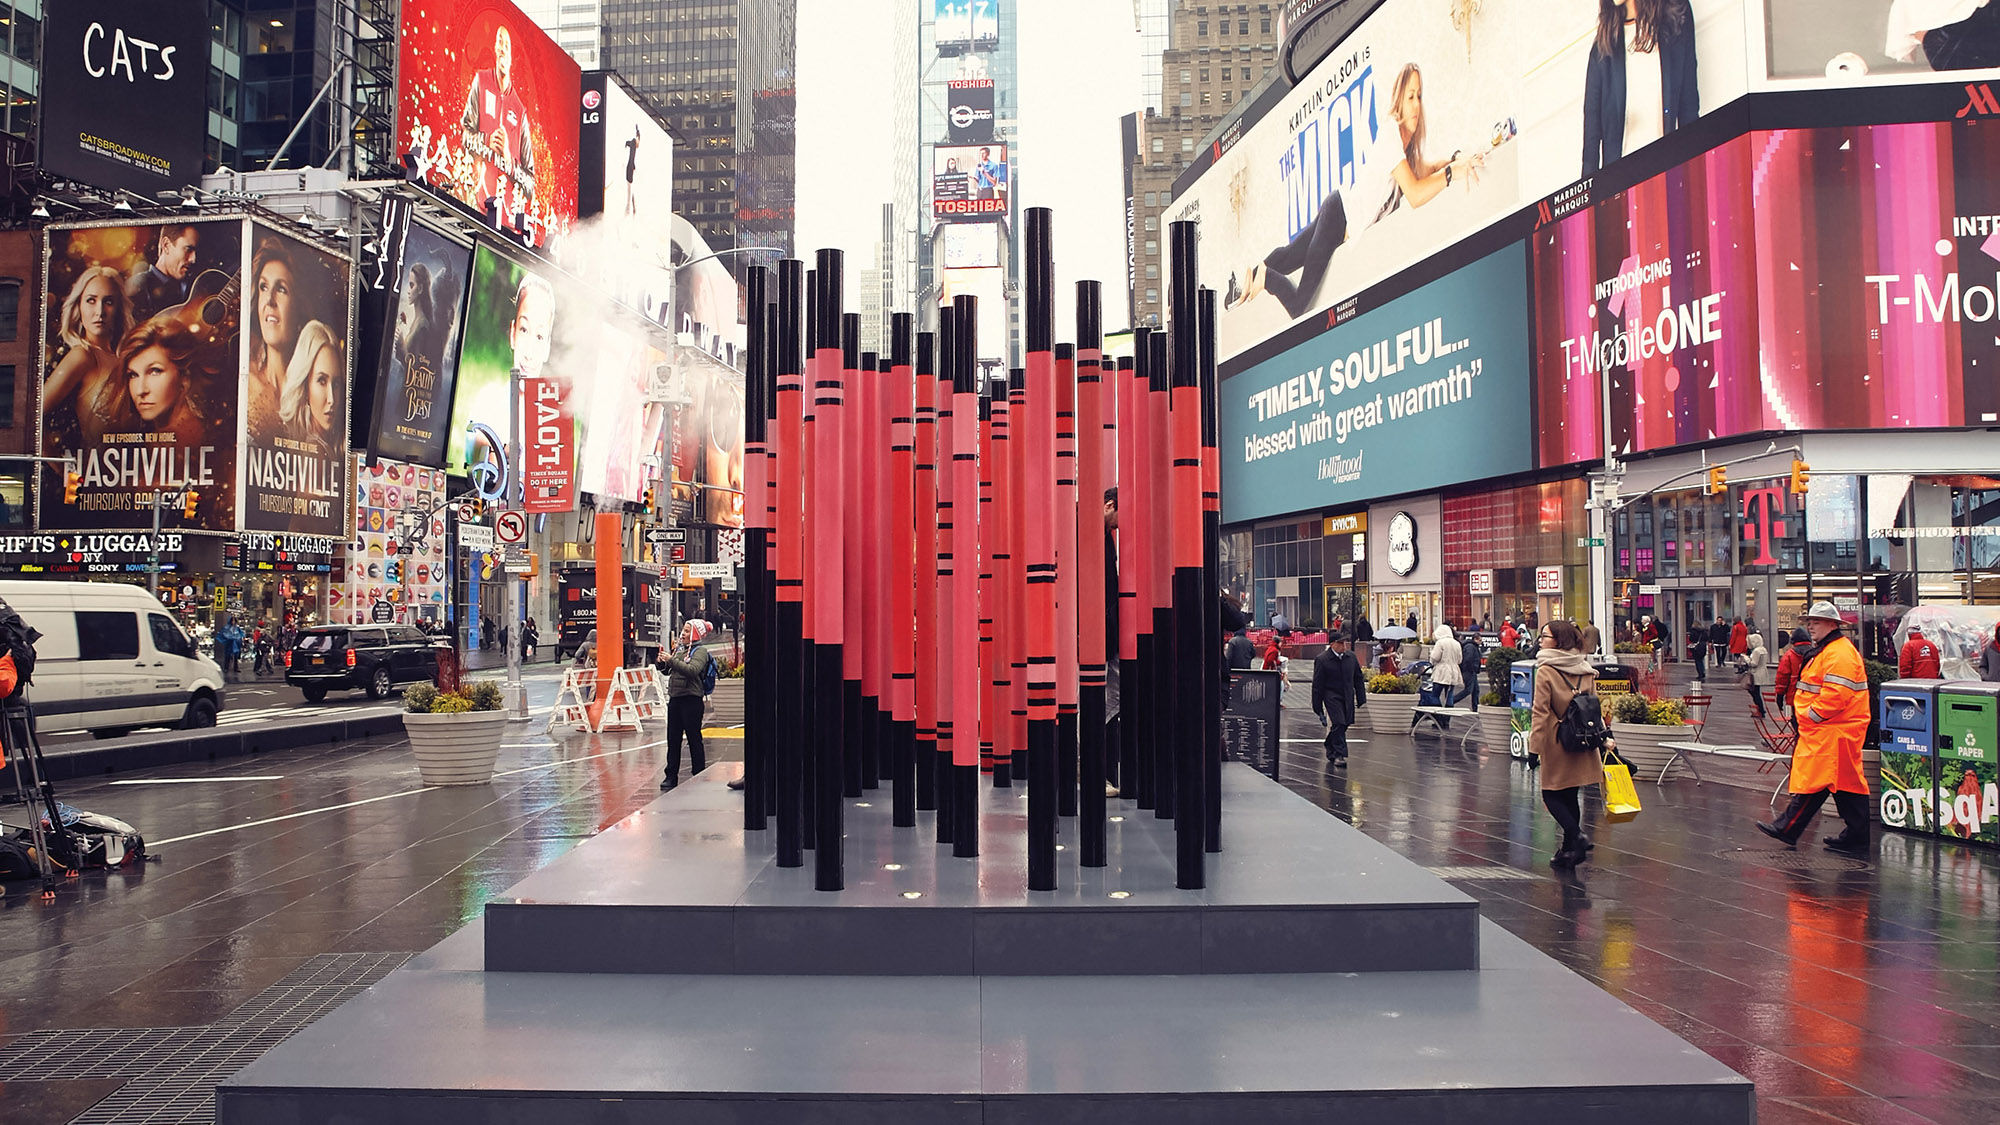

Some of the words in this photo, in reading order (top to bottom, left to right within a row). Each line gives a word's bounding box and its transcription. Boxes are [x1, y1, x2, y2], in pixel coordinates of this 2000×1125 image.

[83, 22, 176, 82] CATS
[949, 81, 993, 89] TOSHIBA
[1289, 88, 1322, 133] KAITLIN
[1326, 52, 1358, 96] OLSON
[1362, 46, 1371, 62] IS
[583, 112, 599, 124] LG
[80, 132, 170, 169] CATSBROADWAY.COM
[1288, 65, 1378, 245] MICK
[1279, 144, 1296, 182] THE
[216, 189, 260, 199] LAMAR
[1553, 178, 1593, 205] MARRIOTT
[936, 201, 1006, 214] TOSHIBA
[1554, 194, 1589, 217] MARQUIS
[1595, 258, 1672, 301] INTRODUCING
[538, 382, 560, 465] LOVE
[1245, 428, 1297, 463] blessed
[1299, 410, 1332, 447] with
[1335, 392, 1384, 444] great
[103, 433, 116, 443] NEW
[145, 432, 158, 442] NEW
[63, 446, 215, 487] NASHVILLE
[249, 447, 339, 498] NASHVILLE
[1318, 449, 1363, 484] Hollywood
[79, 493, 131, 511] THURSDAYS
[259, 493, 293, 514] THURSDAYS
[293, 498, 308, 515] 9PM
[309, 499, 331, 518] CMT
[1332, 516, 1358, 531] INVICTA
[73, 534, 183, 552] LUGGAGE
[283, 536, 333, 555] LUGGAGE
[20, 564, 44, 573] Nikon
[88, 564, 119, 572] SONY
[296, 563, 315, 571] SONY
[1595, 682, 1631, 691] Beautiful
[1897, 736, 1910, 744] CANS
[1906, 743, 1928, 752] BOTTLES
[1957, 746, 1985, 759] PAPER
